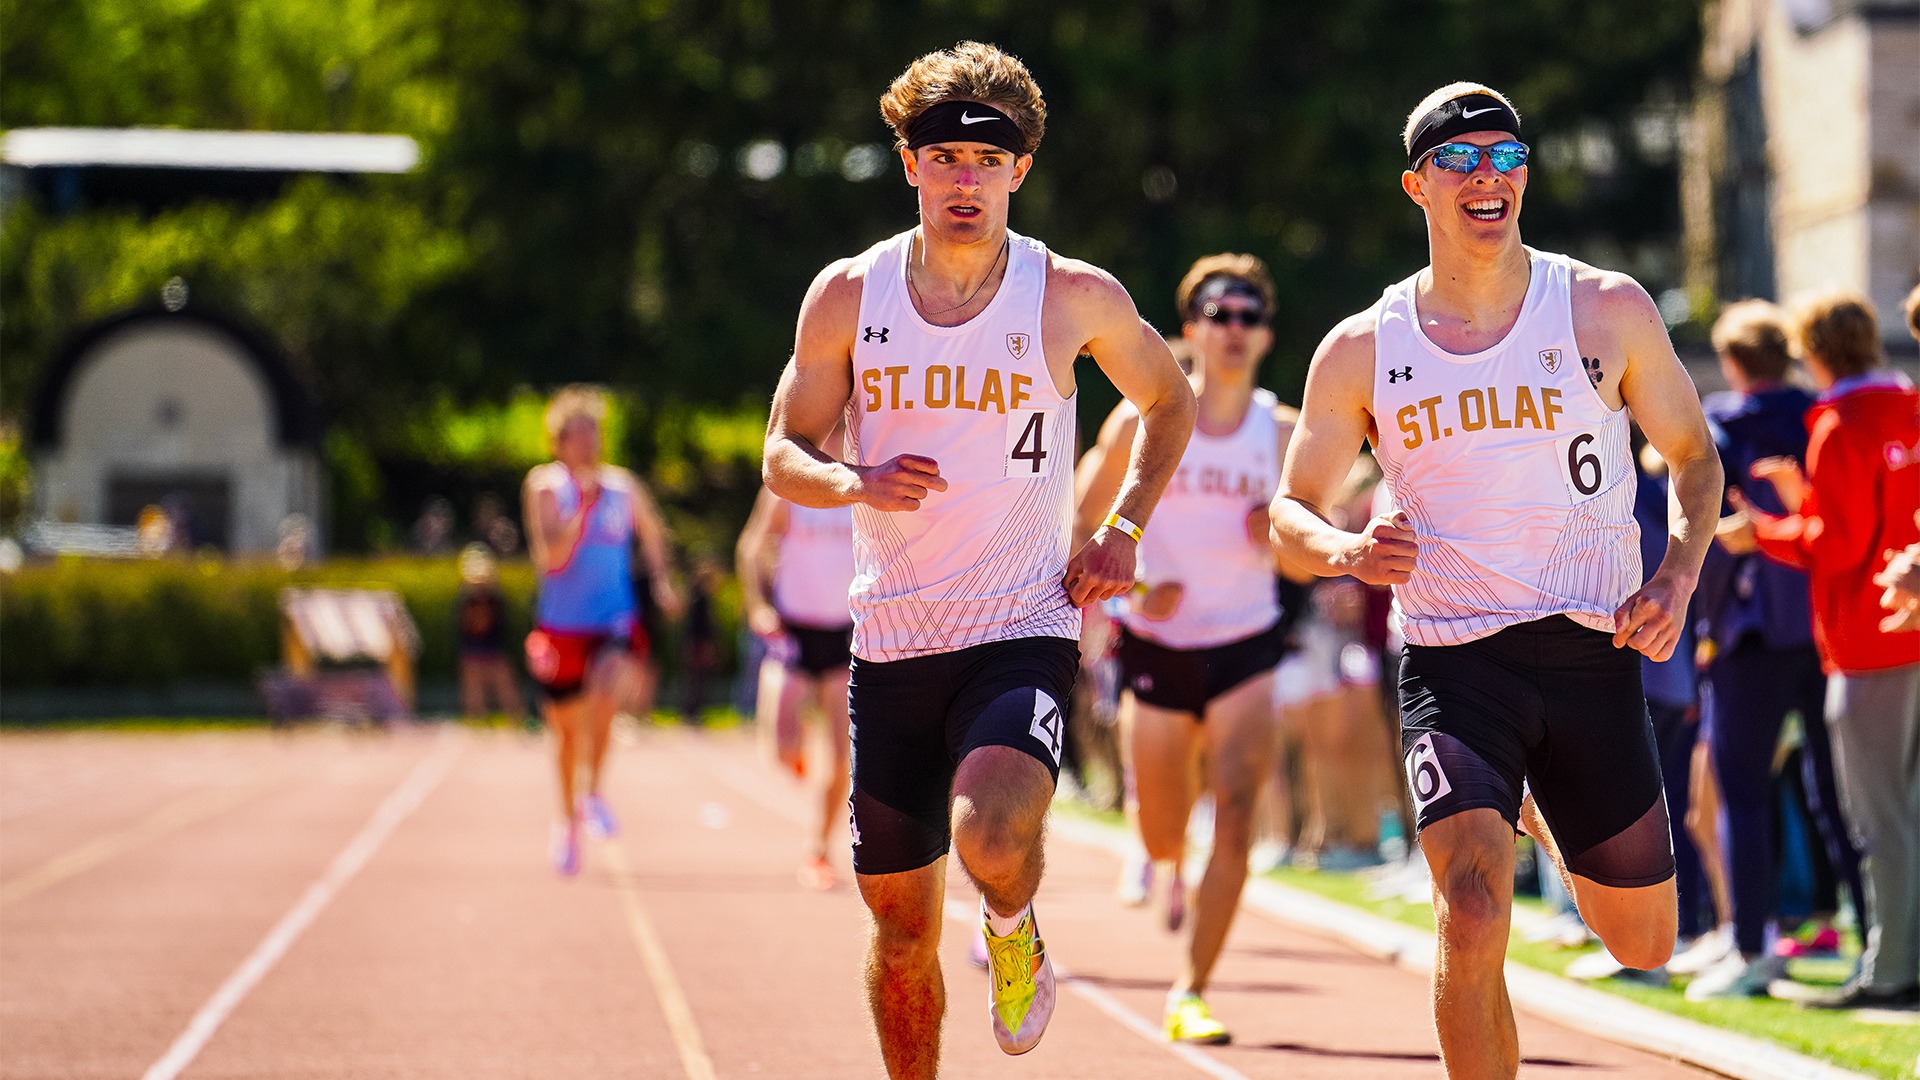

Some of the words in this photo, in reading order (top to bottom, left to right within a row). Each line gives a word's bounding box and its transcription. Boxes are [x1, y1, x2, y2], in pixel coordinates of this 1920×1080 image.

[862, 365, 914, 412] ST.
[924, 365, 1033, 414] OLAF
[1396, 395, 1453, 450] ST.
[1458, 386, 1563, 432] OLAF
[1011, 412, 1047, 473] 4
[1568, 433, 1602, 496] 6
[1038, 705, 1060, 756] 4
[1410, 743, 1441, 802] 6
